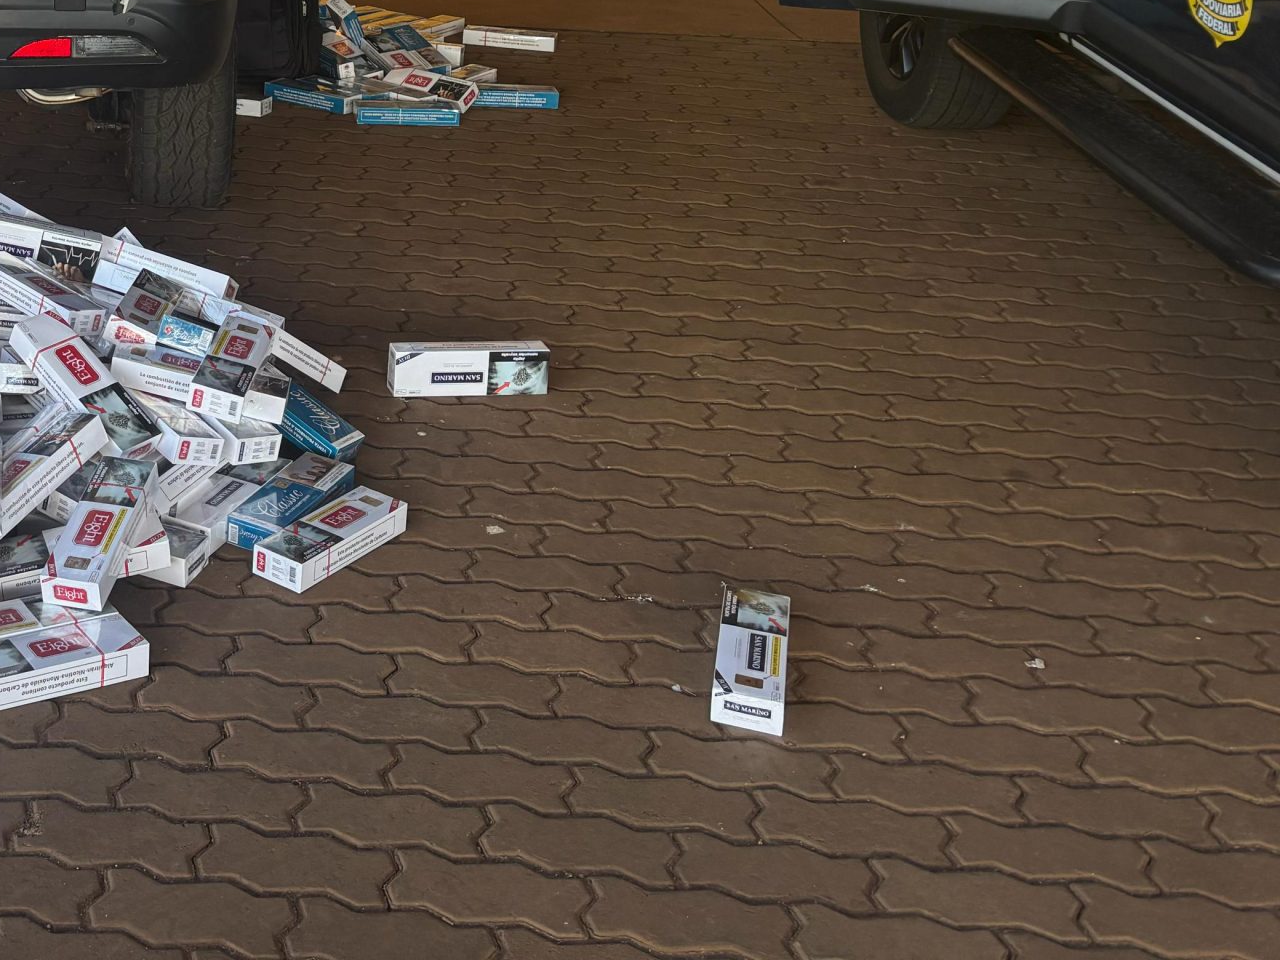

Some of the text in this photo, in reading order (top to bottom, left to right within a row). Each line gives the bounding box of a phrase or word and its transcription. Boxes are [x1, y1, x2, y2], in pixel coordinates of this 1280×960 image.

[1197, 8, 1234, 36] FEDERAL
[16, 248, 33, 256] SAN
[63, 350, 91, 382] Eight
[147, 374, 174, 384] combustión
[32, 479, 40, 488] este
[40, 467, 56, 483] producto
[56, 457, 66, 469] libera
[249, 488, 304, 518] Classic
[327, 510, 360, 526] Eight
[84, 514, 109, 543] Eight
[57, 587, 85, 600] Eight
[35, 634, 87, 653] Eight
[22, 686, 47, 696] contiene
[47, 679, 75, 690] producto
[726, 702, 769, 716] SAN MARINO
